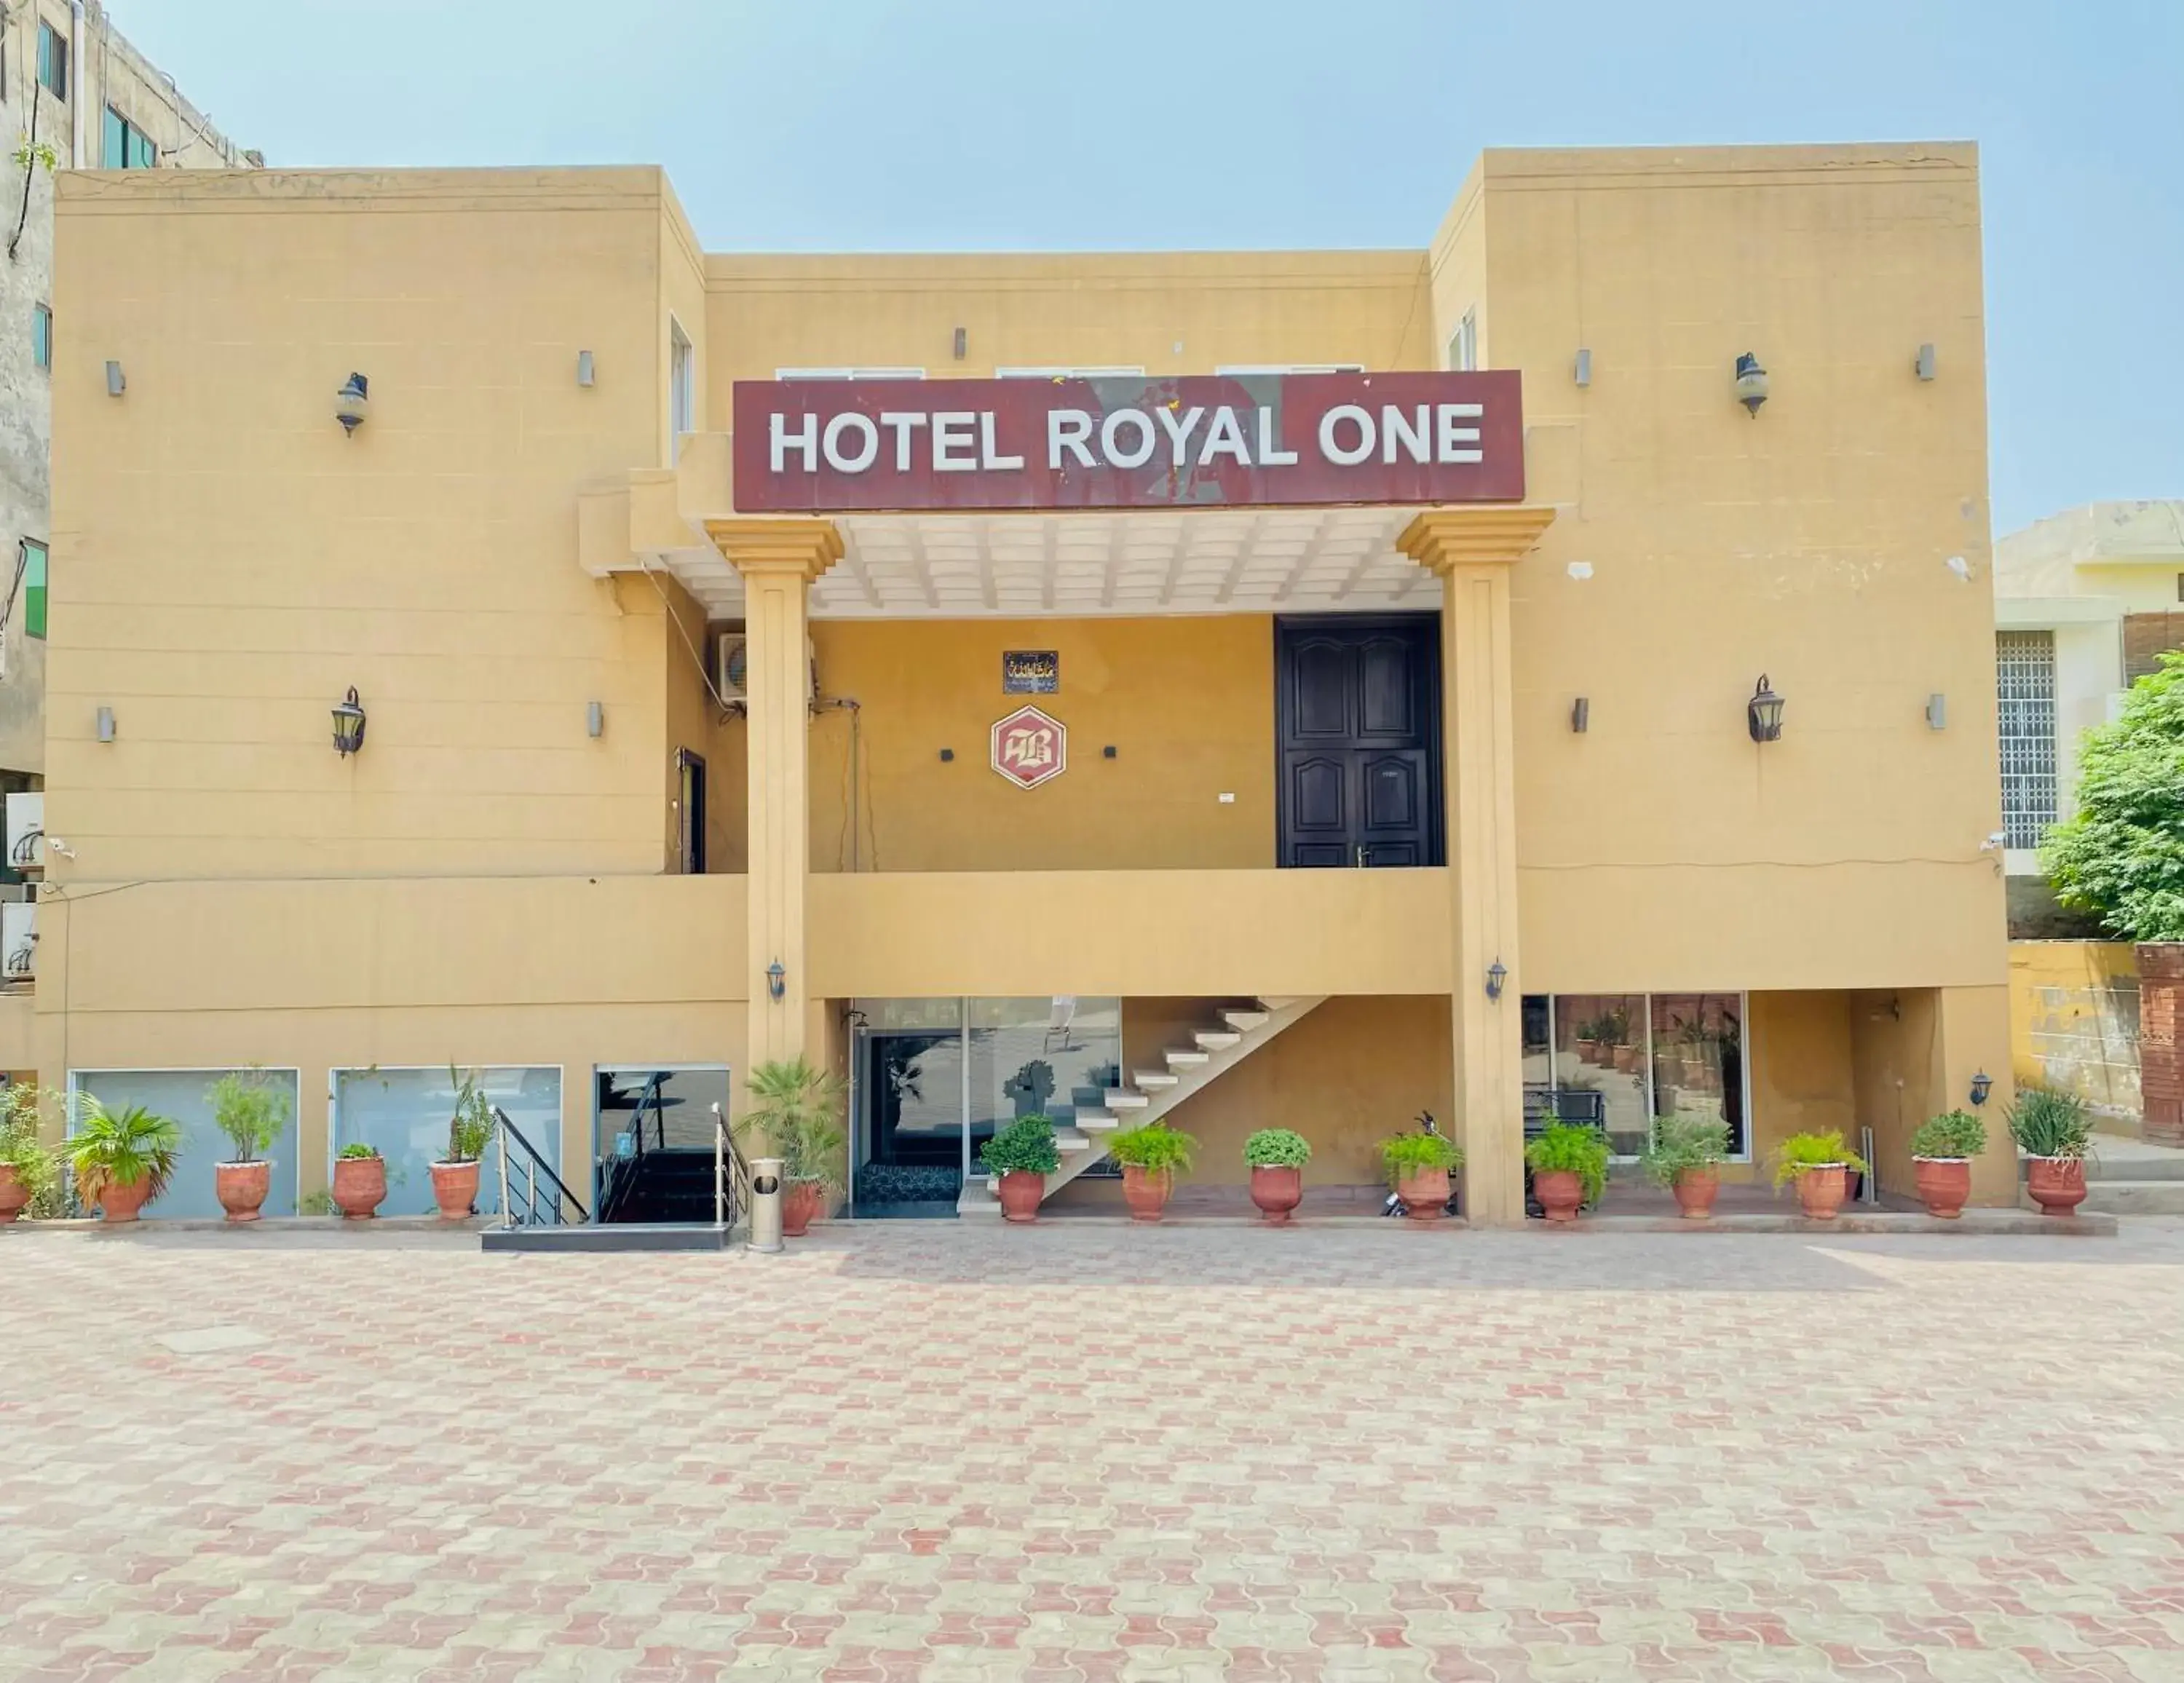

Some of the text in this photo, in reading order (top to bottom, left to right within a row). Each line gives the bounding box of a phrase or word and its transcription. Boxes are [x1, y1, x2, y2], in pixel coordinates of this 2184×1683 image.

[769, 403, 1484, 474] HOTEL ROYAL ONE
